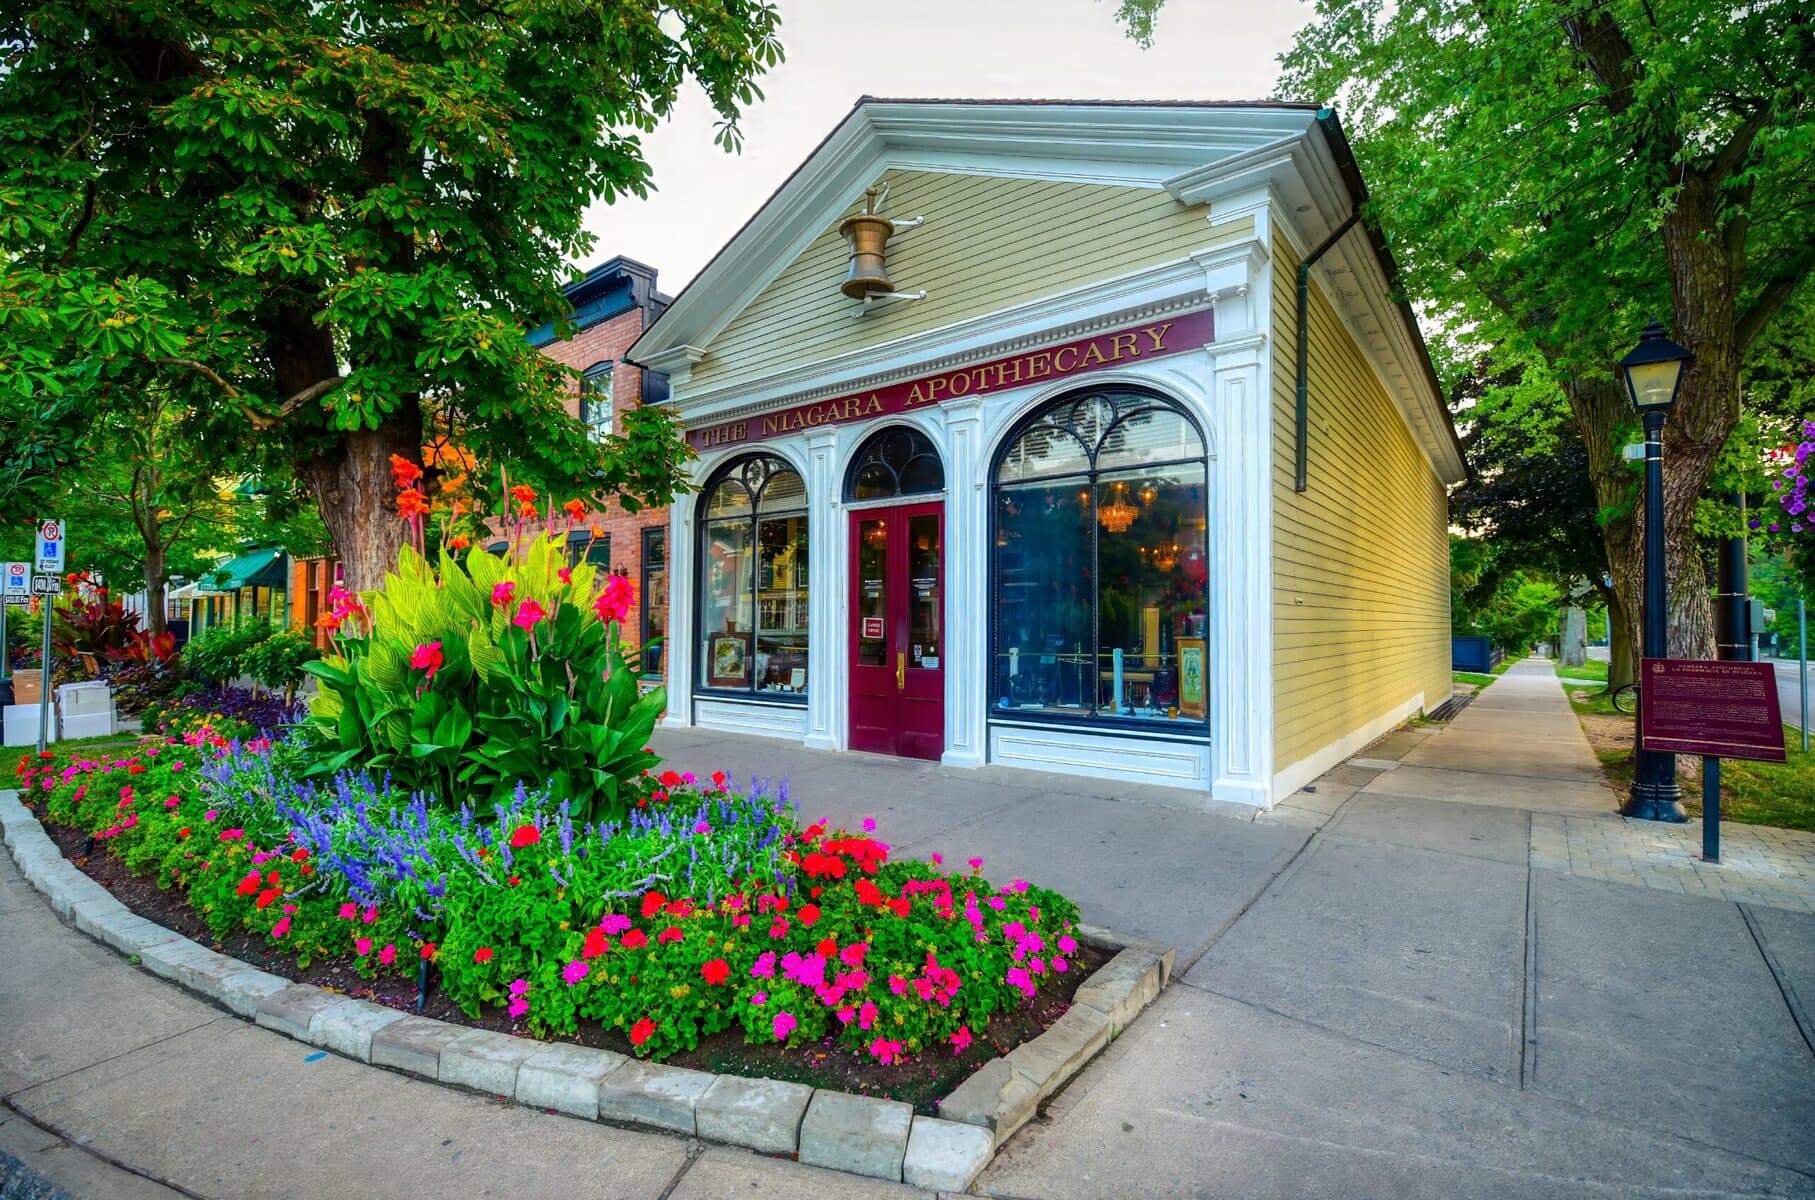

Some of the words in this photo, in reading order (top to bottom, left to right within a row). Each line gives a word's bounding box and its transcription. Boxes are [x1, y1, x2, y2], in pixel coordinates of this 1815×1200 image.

[702, 422, 748, 447] THE
[761, 393, 884, 435] NIAGARA
[904, 323, 1172, 405] APOTHECARY
